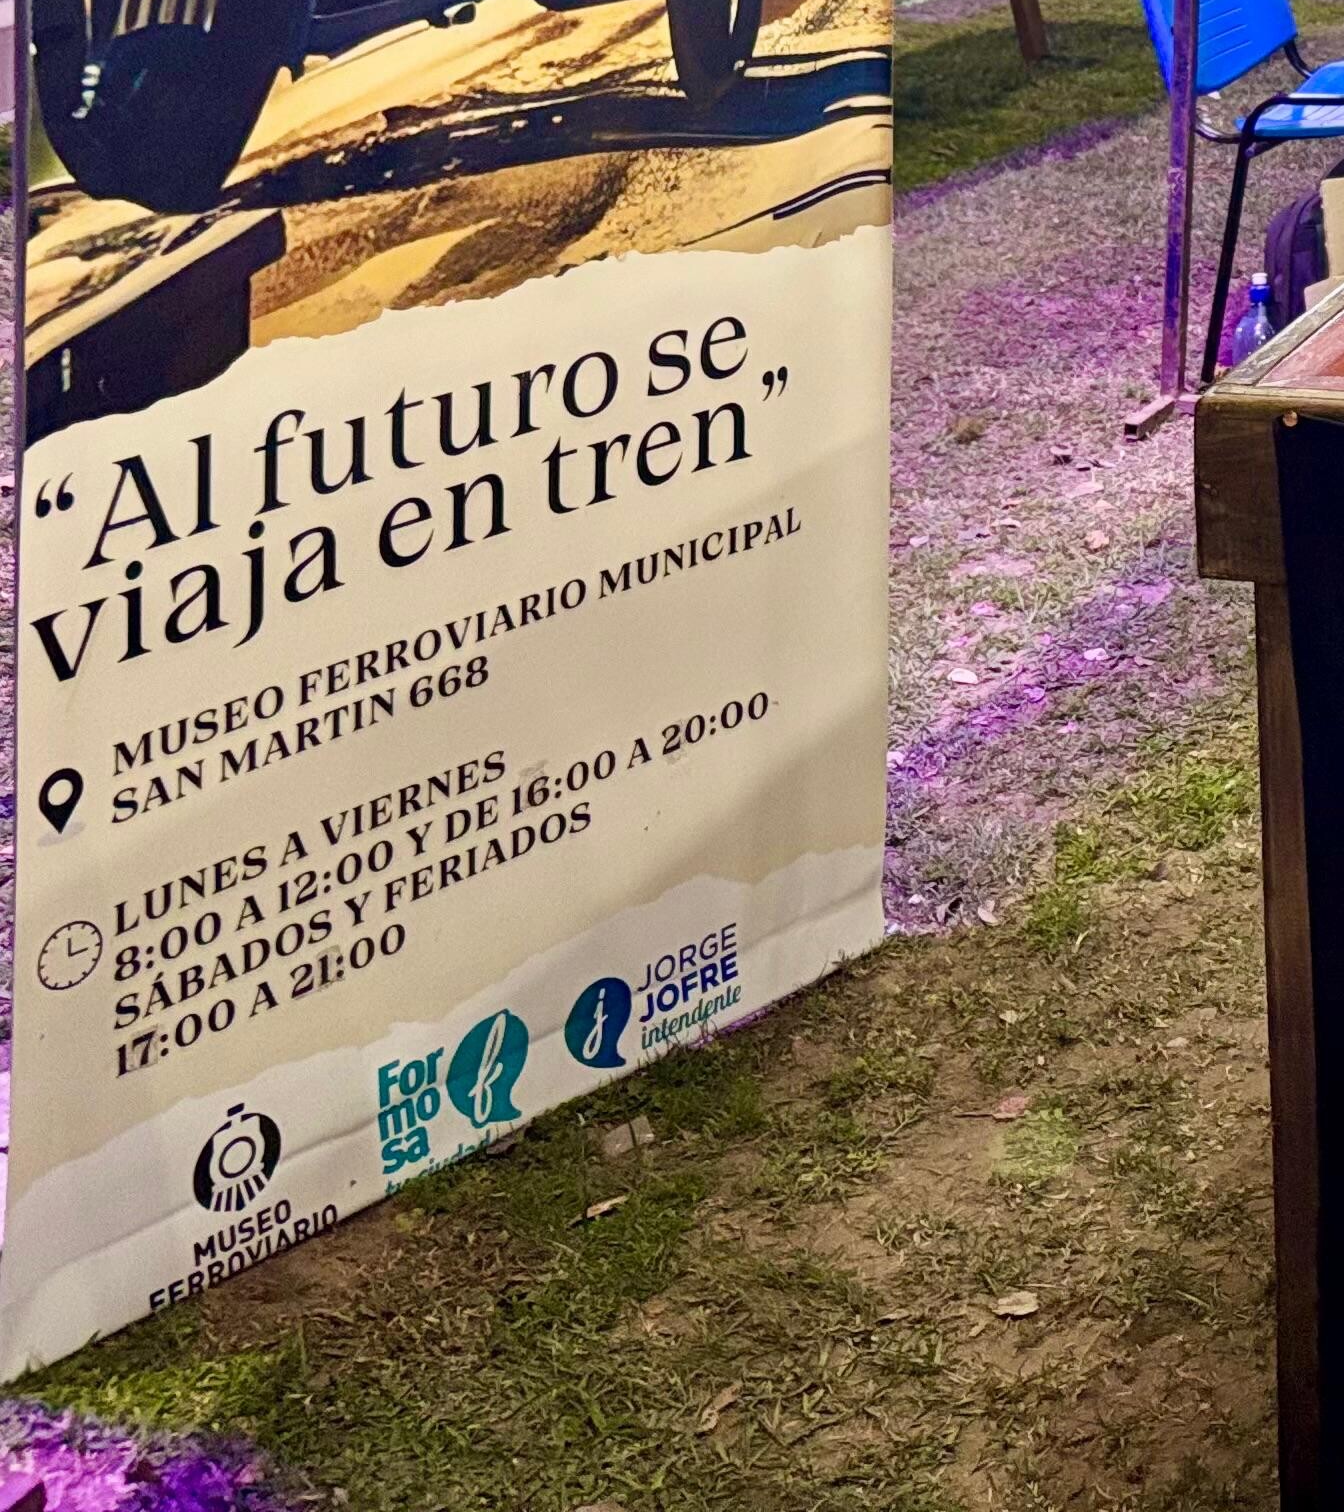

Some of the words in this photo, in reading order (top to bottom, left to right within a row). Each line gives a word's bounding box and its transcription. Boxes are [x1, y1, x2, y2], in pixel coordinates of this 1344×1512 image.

[35, 434, 220, 570] “Al
[254, 351, 618, 515] futuro
[647, 316, 749, 396] se
[30, 521, 345, 681] viaja
[379, 473, 512, 568] en
[541, 366, 788, 515] tren”
[112, 686, 284, 776] MUSEO
[298, 578, 586, 706] FERROVIARIO
[598, 507, 801, 599] MUNICIPAL
[111, 759, 205, 823] SAN
[219, 687, 396, 782] MARTIN
[409, 655, 489, 708] 668
[113, 845, 267, 936] LUNES
[279, 831, 309, 867] A
[320, 750, 505, 846] VIERNES
[114, 912, 221, 982] 8:00
[235, 895, 266, 931] A
[277, 840, 393, 913] 12:00
[406, 822, 433, 856] Y
[445, 795, 499, 843] DE
[512, 750, 616, 817] 16:00
[627, 737, 652, 770] A
[662, 692, 769, 755] 20:00
[114, 909, 333, 1030] SÁBADOS
[344, 890, 372, 927] Y
[384, 802, 591, 913] FERIADOS
[637, 923, 736, 991] JORGE
[639, 950, 739, 1022] JOFRE
[116, 998, 235, 1078] 17:00
[249, 981, 279, 1017] A
[290, 924, 405, 999] 21:00
[377, 1046, 445, 1108] For
[641, 984, 742, 1049] intendente
[377, 1086, 441, 1141] mo
[381, 1126, 430, 1174] sa
[194, 1199, 291, 1266] MUSEO
